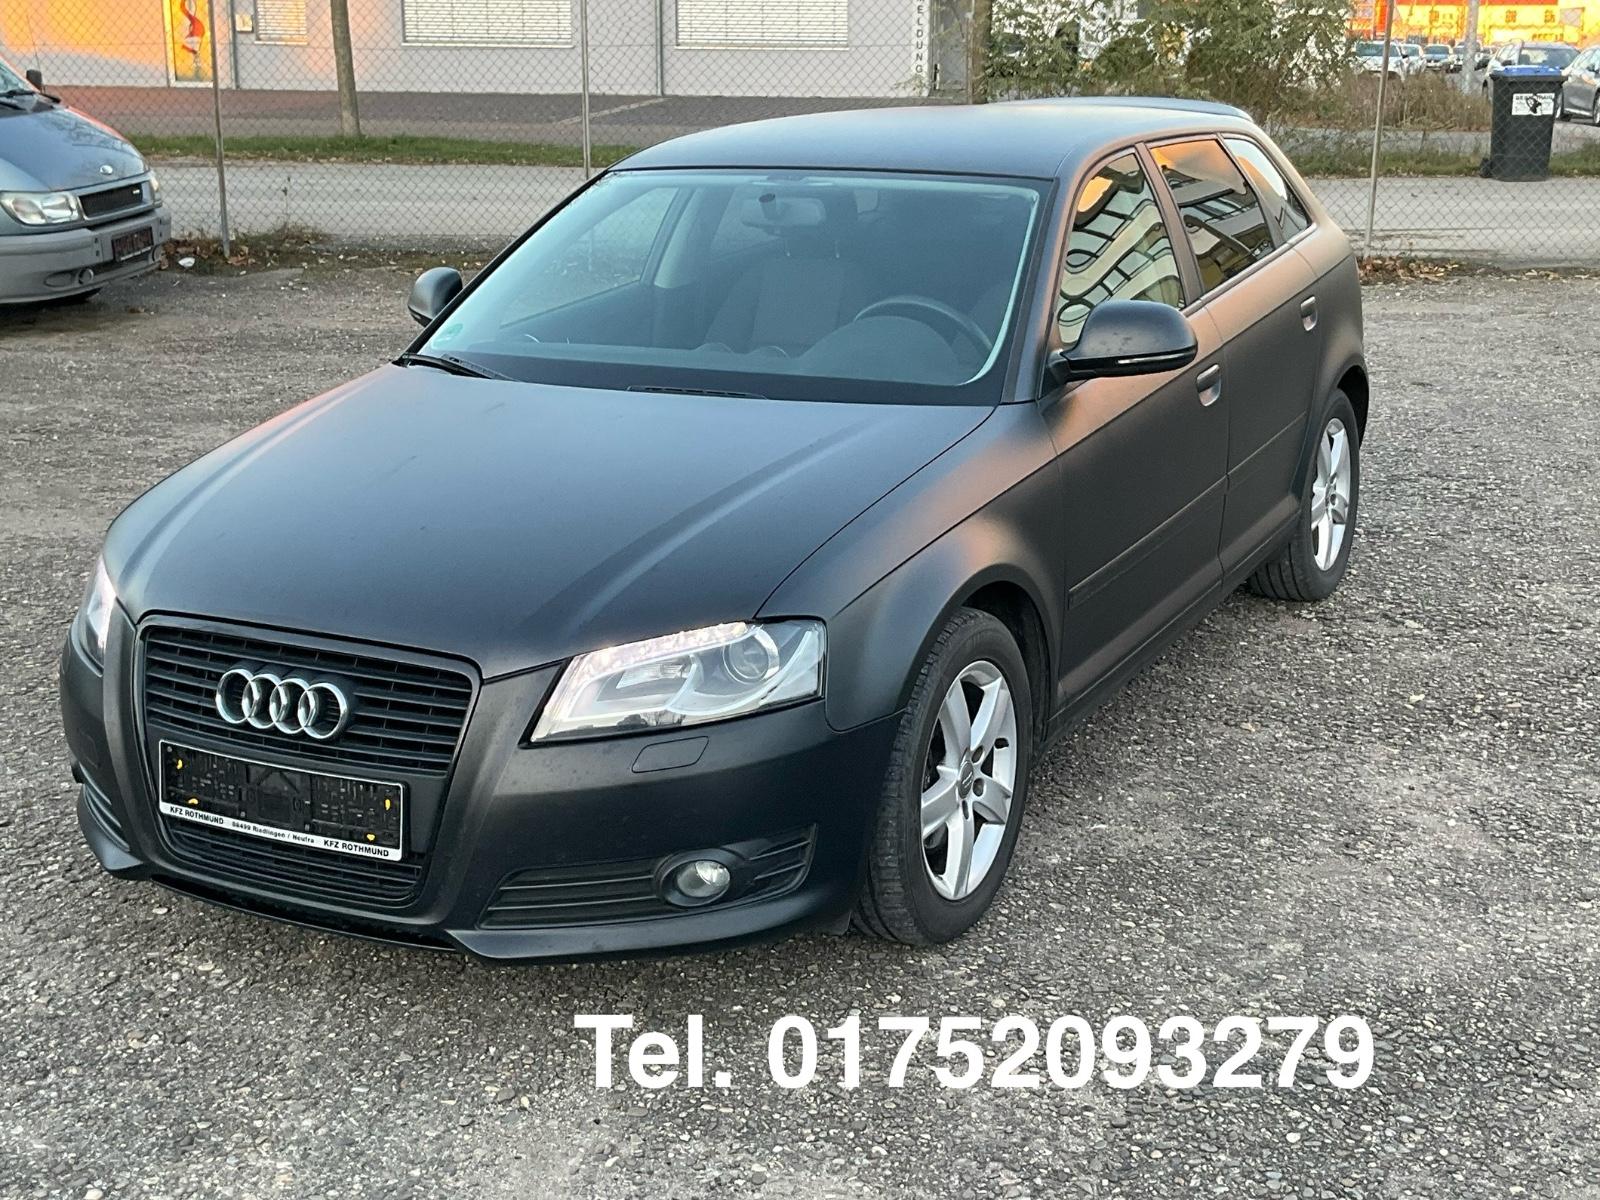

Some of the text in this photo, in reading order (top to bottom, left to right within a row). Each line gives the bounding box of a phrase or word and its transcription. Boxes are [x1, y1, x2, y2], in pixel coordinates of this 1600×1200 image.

[915, 0, 924, 73] ELDUNG
[170, 806, 183, 815] KFZ
[184, 809, 224, 825] ROTHMUND
[252, 825, 286, 838] Riedlingen
[323, 840, 340, 849] KFZ
[341, 842, 390, 857] ROTHMUND
